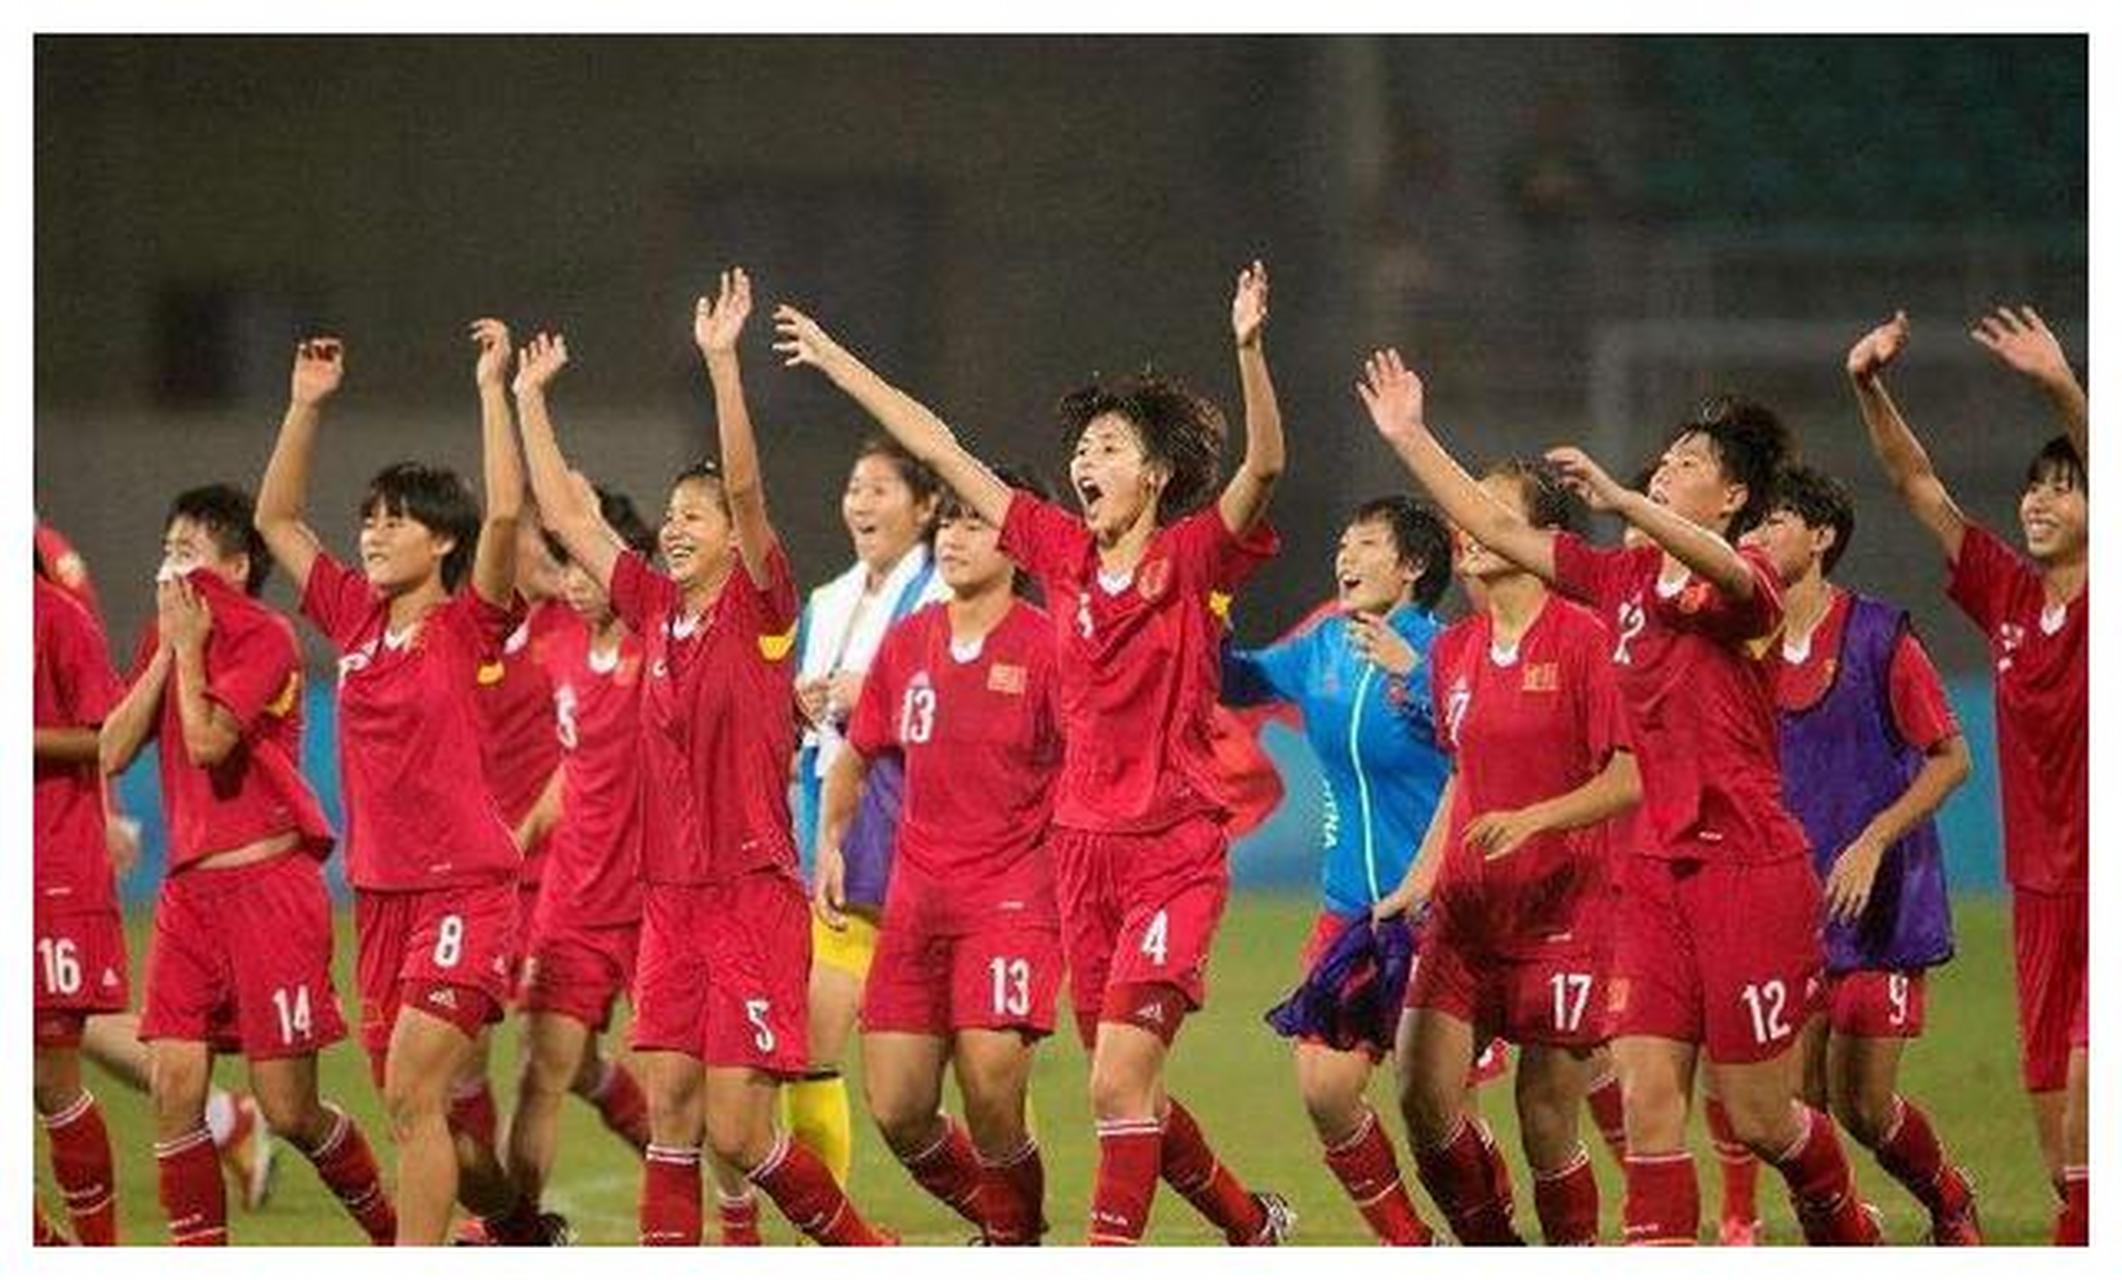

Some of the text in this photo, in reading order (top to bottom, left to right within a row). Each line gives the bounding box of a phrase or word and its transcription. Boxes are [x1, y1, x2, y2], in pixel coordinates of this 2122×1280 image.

[900, 687, 936, 743] 13
[37, 937, 82, 994] 16
[433, 914, 463, 968] 8
[1140, 908, 1168, 966] 4
[272, 985, 312, 1045] 14
[989, 956, 1030, 1016] 13
[1550, 973, 1593, 1031] 17
[1741, 980, 1791, 1044] 12
[745, 999, 775, 1053] 5
